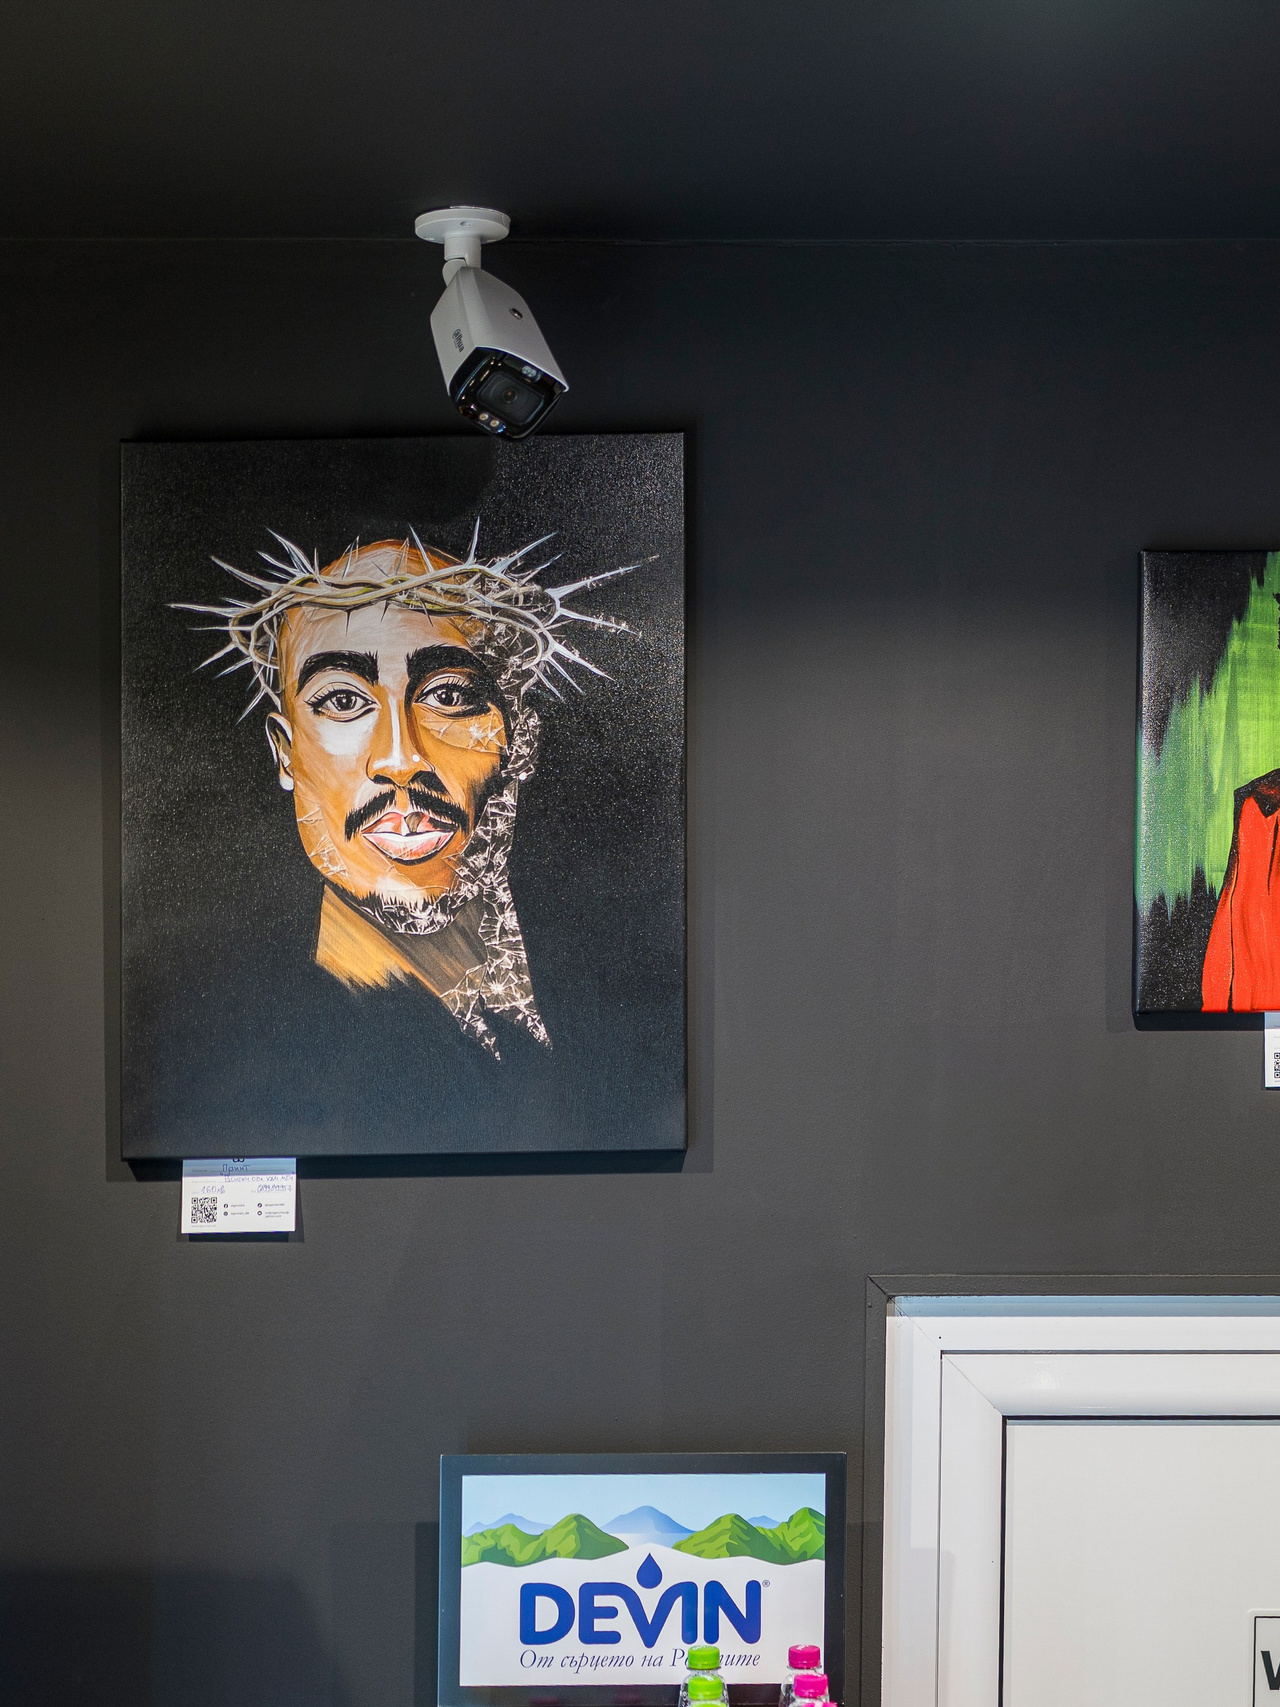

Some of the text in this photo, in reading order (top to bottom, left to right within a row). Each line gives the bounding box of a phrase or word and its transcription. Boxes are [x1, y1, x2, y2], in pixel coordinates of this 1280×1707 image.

[519, 1649, 555, 1668] От
[560, 1652, 635, 1675] сърцето
[640, 1655, 664, 1667] на
